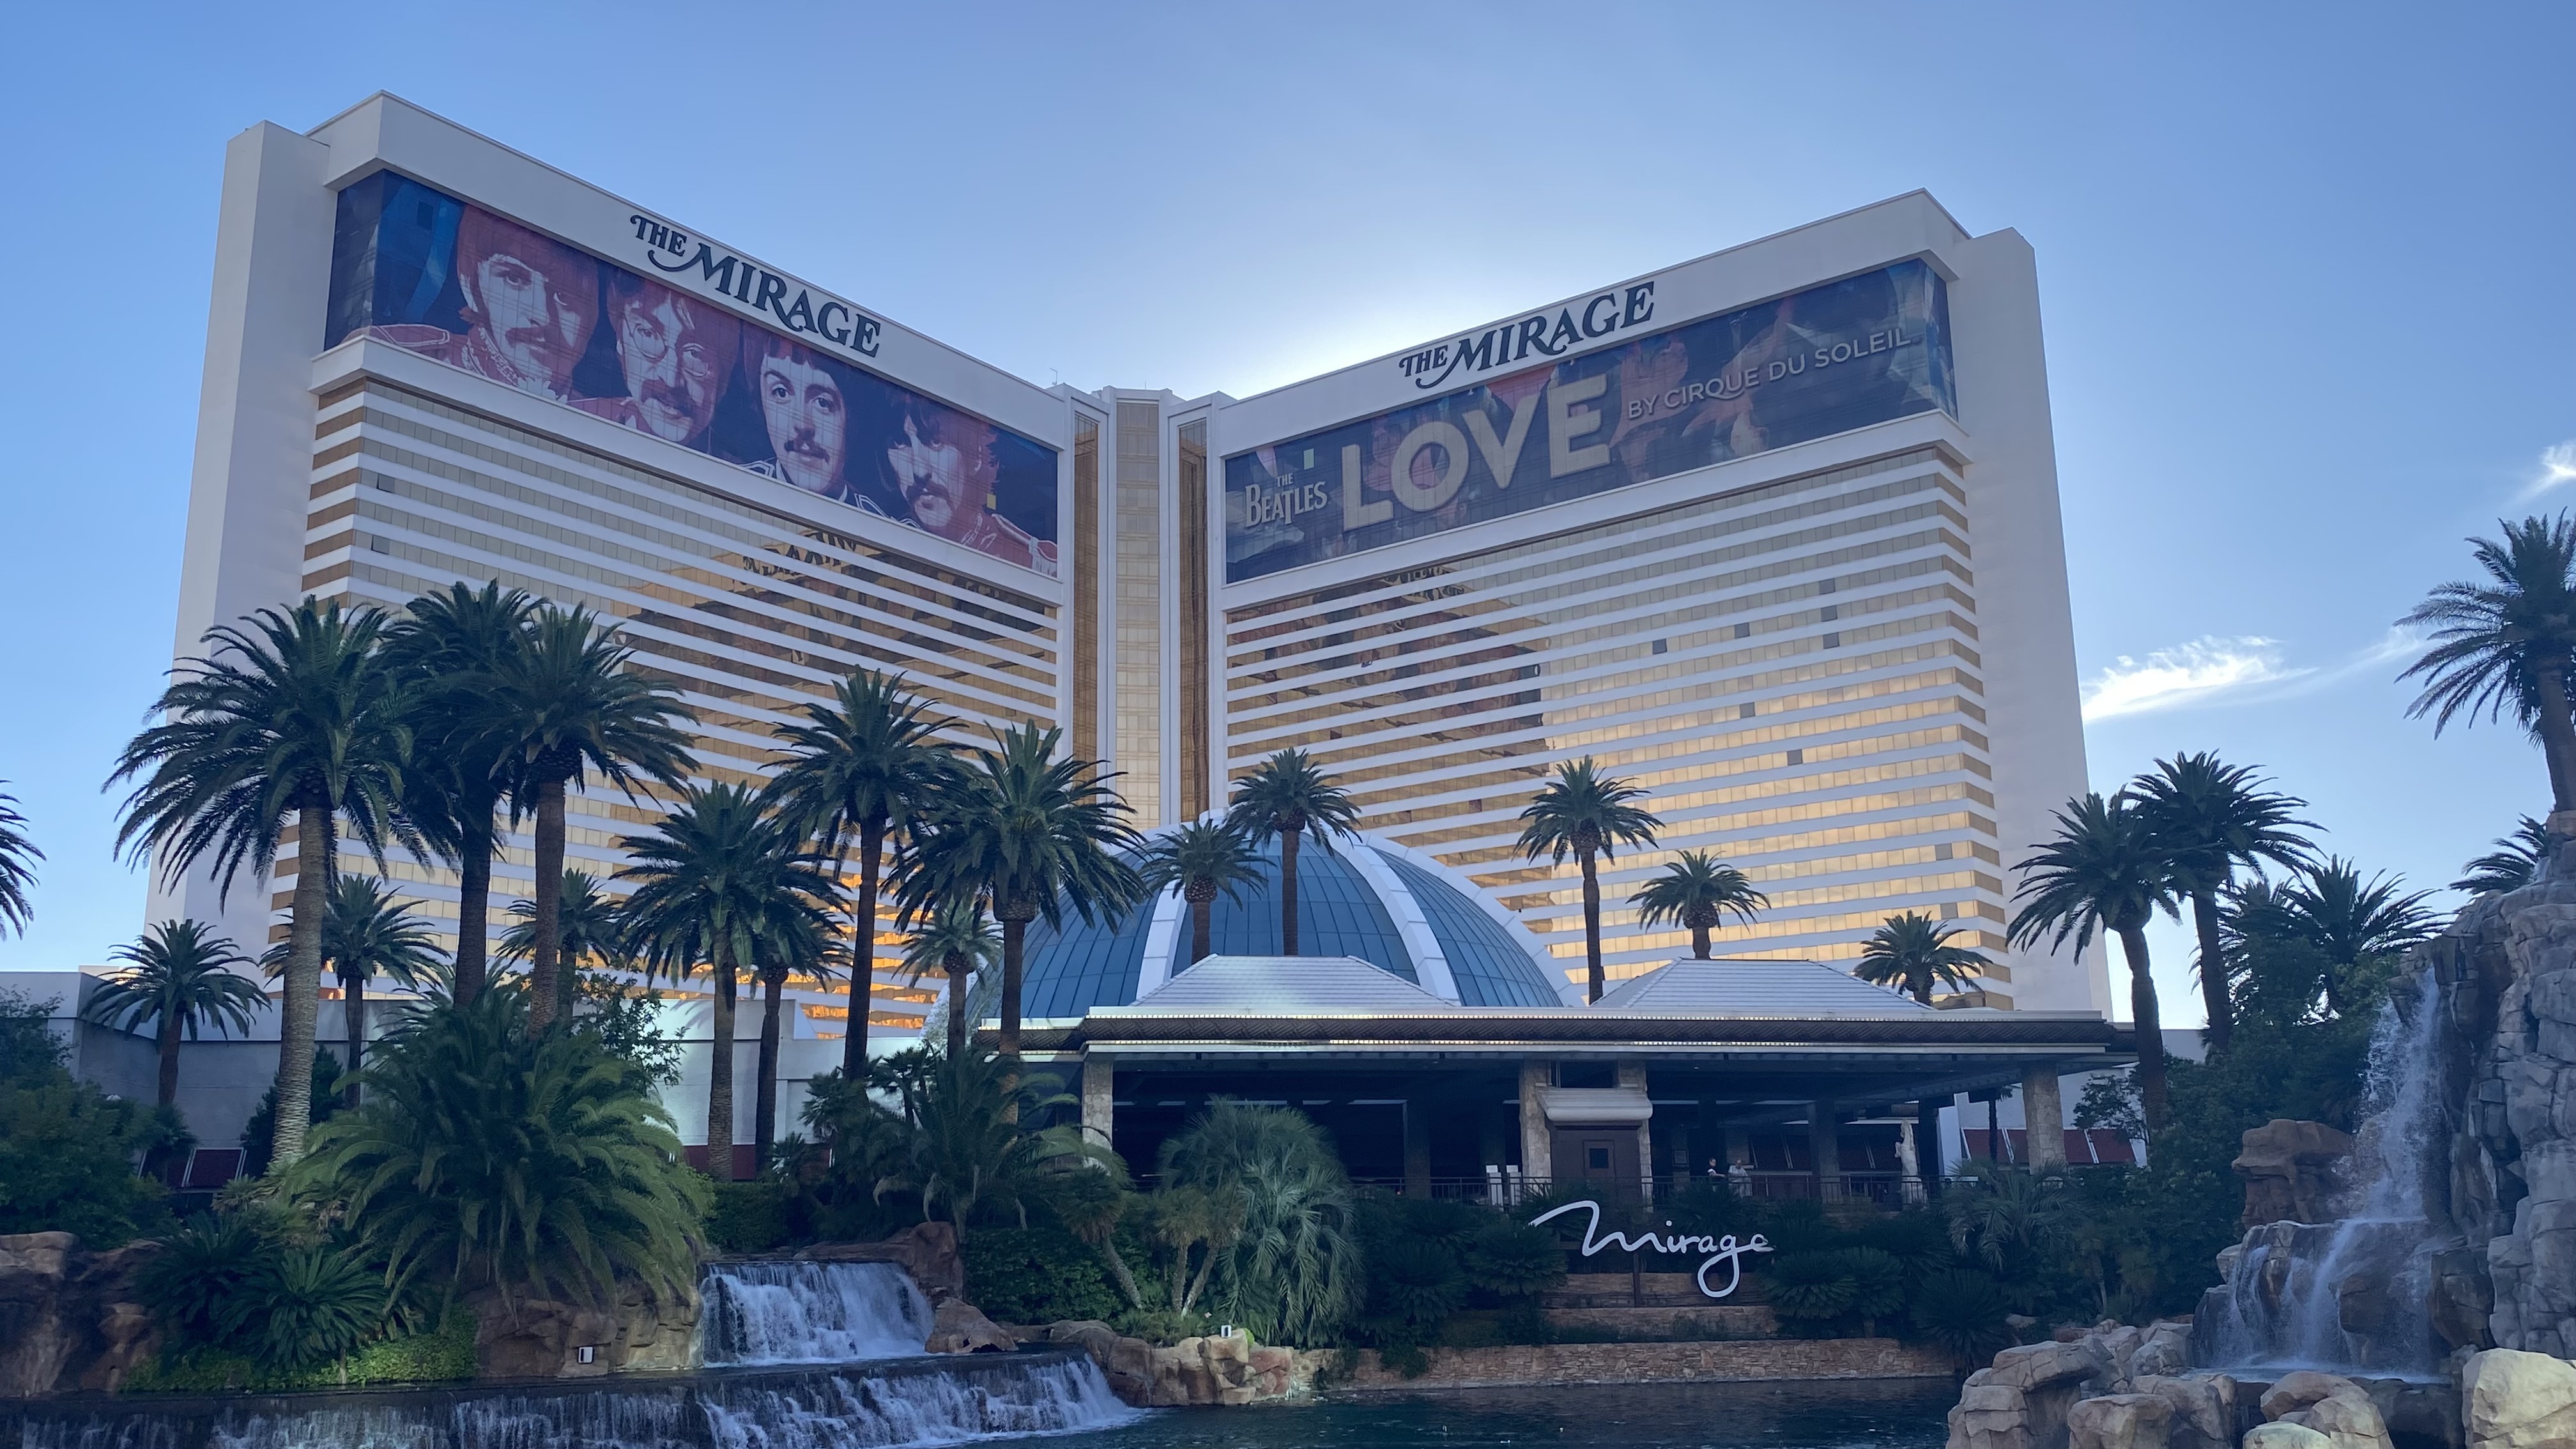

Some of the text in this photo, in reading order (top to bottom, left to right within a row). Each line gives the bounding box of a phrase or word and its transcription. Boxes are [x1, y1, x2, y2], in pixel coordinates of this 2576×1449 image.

[630, 215, 882, 358] THE MIRAGE
[1399, 281, 1655, 389] THE MIRAGE
[1628, 327, 1912, 420] BY CIRQUE DU SOLEIL
[1276, 473, 1294, 487] THE
[1342, 374, 1612, 532] LOVE
[1245, 480, 1329, 528] BEATLES
